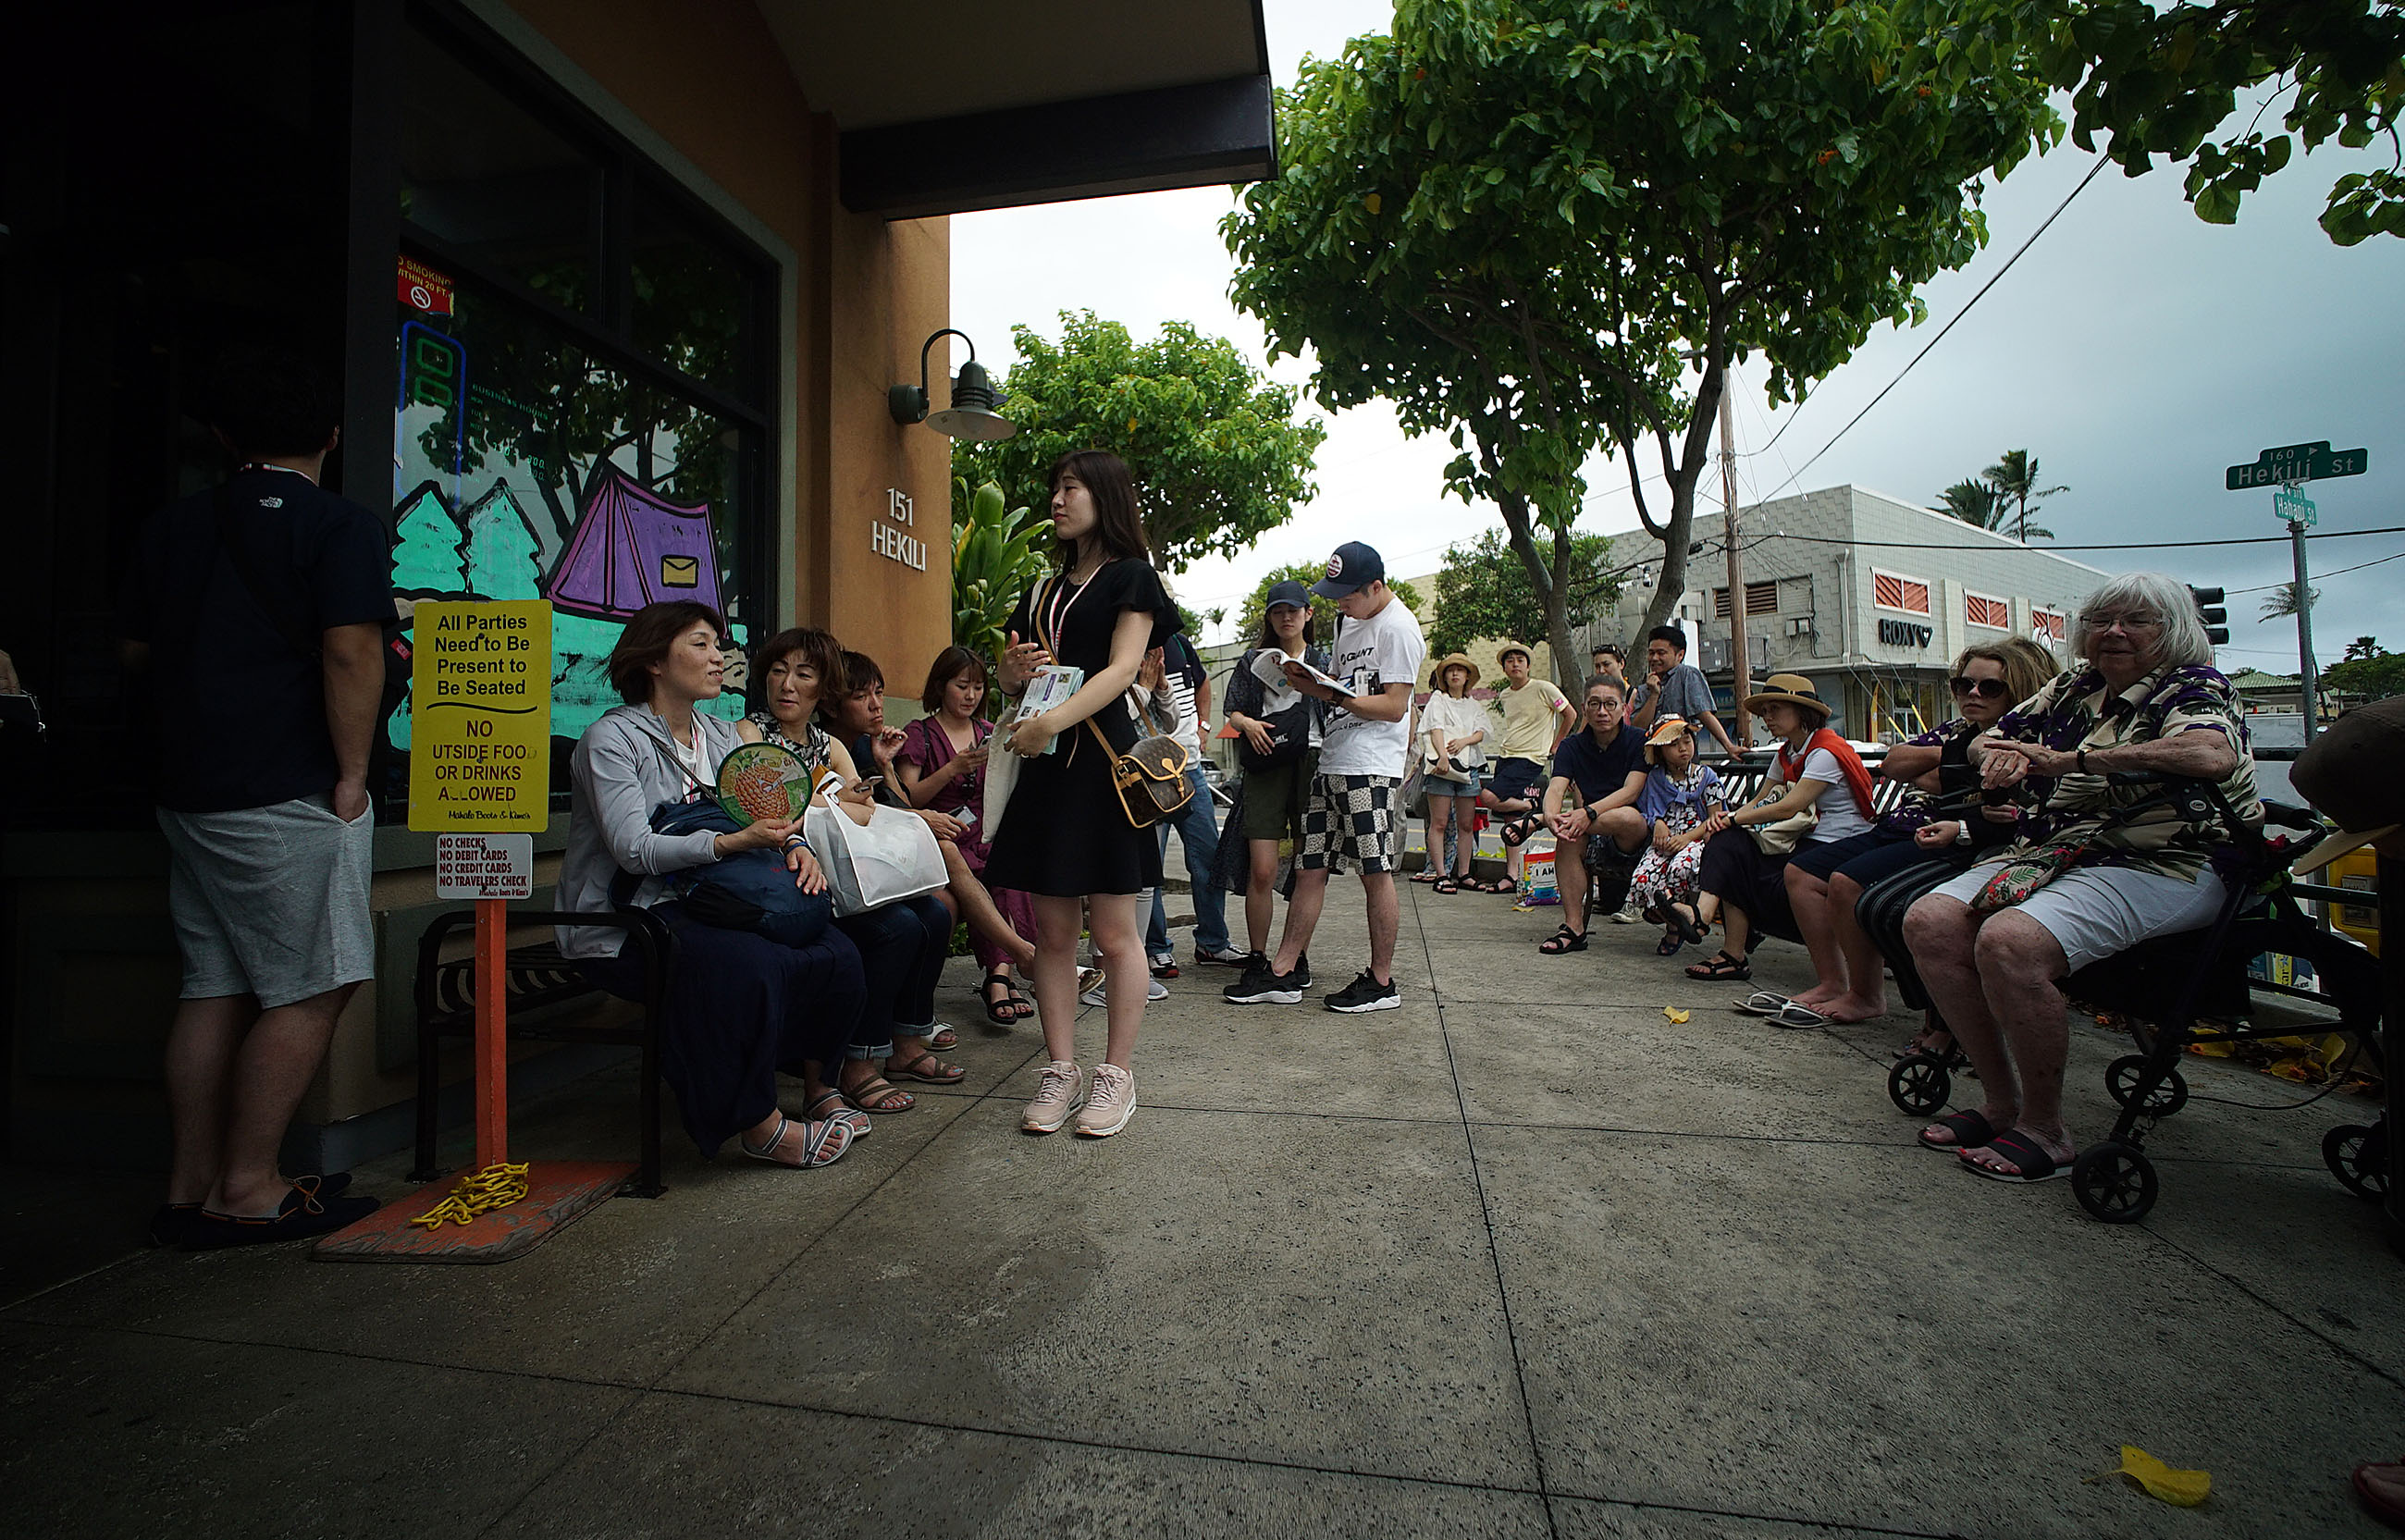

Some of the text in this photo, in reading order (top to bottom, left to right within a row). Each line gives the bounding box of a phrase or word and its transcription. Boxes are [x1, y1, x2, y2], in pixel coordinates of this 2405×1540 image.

[425, 280, 435, 291] 20
[2270, 449, 2294, 462] 160
[2238, 457, 2353, 486] Hekili St
[887, 487, 912, 526] 151
[871, 520, 926, 572] HEKILI
[438, 613, 528, 631] All Parties
[1879, 619, 1918, 647] ROXY
[435, 635, 530, 652] Need to Be
[438, 658, 527, 674] Present to
[438, 679, 525, 696] Be Seated
[466, 720, 493, 737] NO
[435, 765, 522, 781] OR DRINKS
[438, 786, 516, 801] AOWED
[475, 810, 498, 819] Boots
[500, 811, 508, 819] &
[439, 837, 486, 849] NO CHECKS
[439, 850, 508, 861] NO DEBIT CARDS
[439, 863, 512, 874] NO CREDIT CARDS
[439, 875, 527, 886] NO TRAVELERS CHECK
